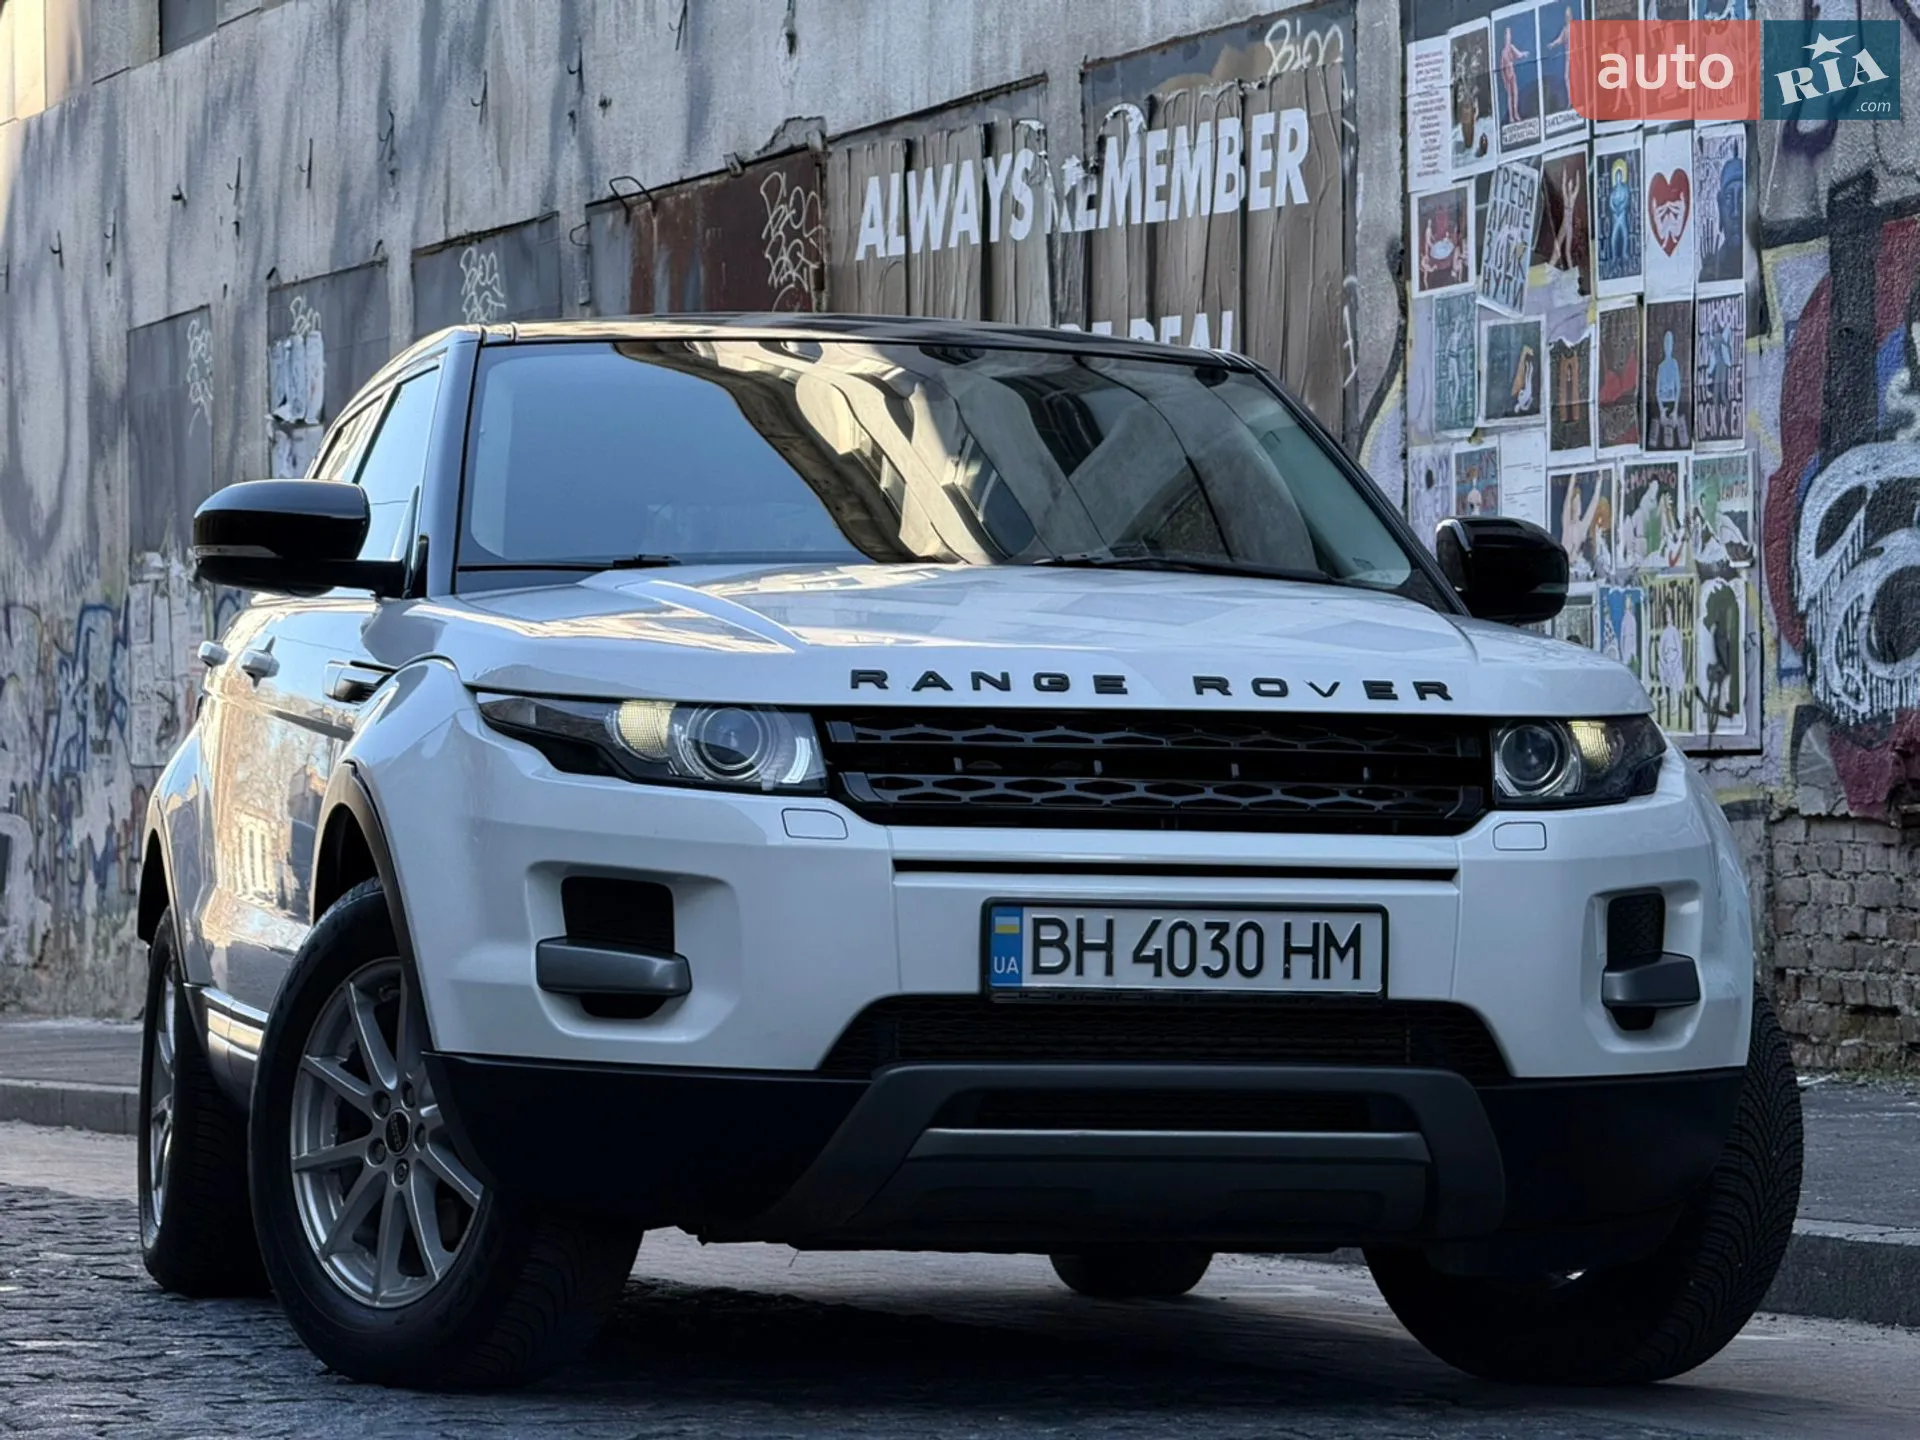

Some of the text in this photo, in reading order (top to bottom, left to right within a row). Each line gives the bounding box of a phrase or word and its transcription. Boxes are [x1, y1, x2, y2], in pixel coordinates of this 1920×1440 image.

[855, 149, 1035, 262] ALWAYS
[850, 669, 1453, 701] RANGE ROVER
[994, 956, 1019, 974] UA
[1031, 916, 1362, 980] BH 4030 HM
